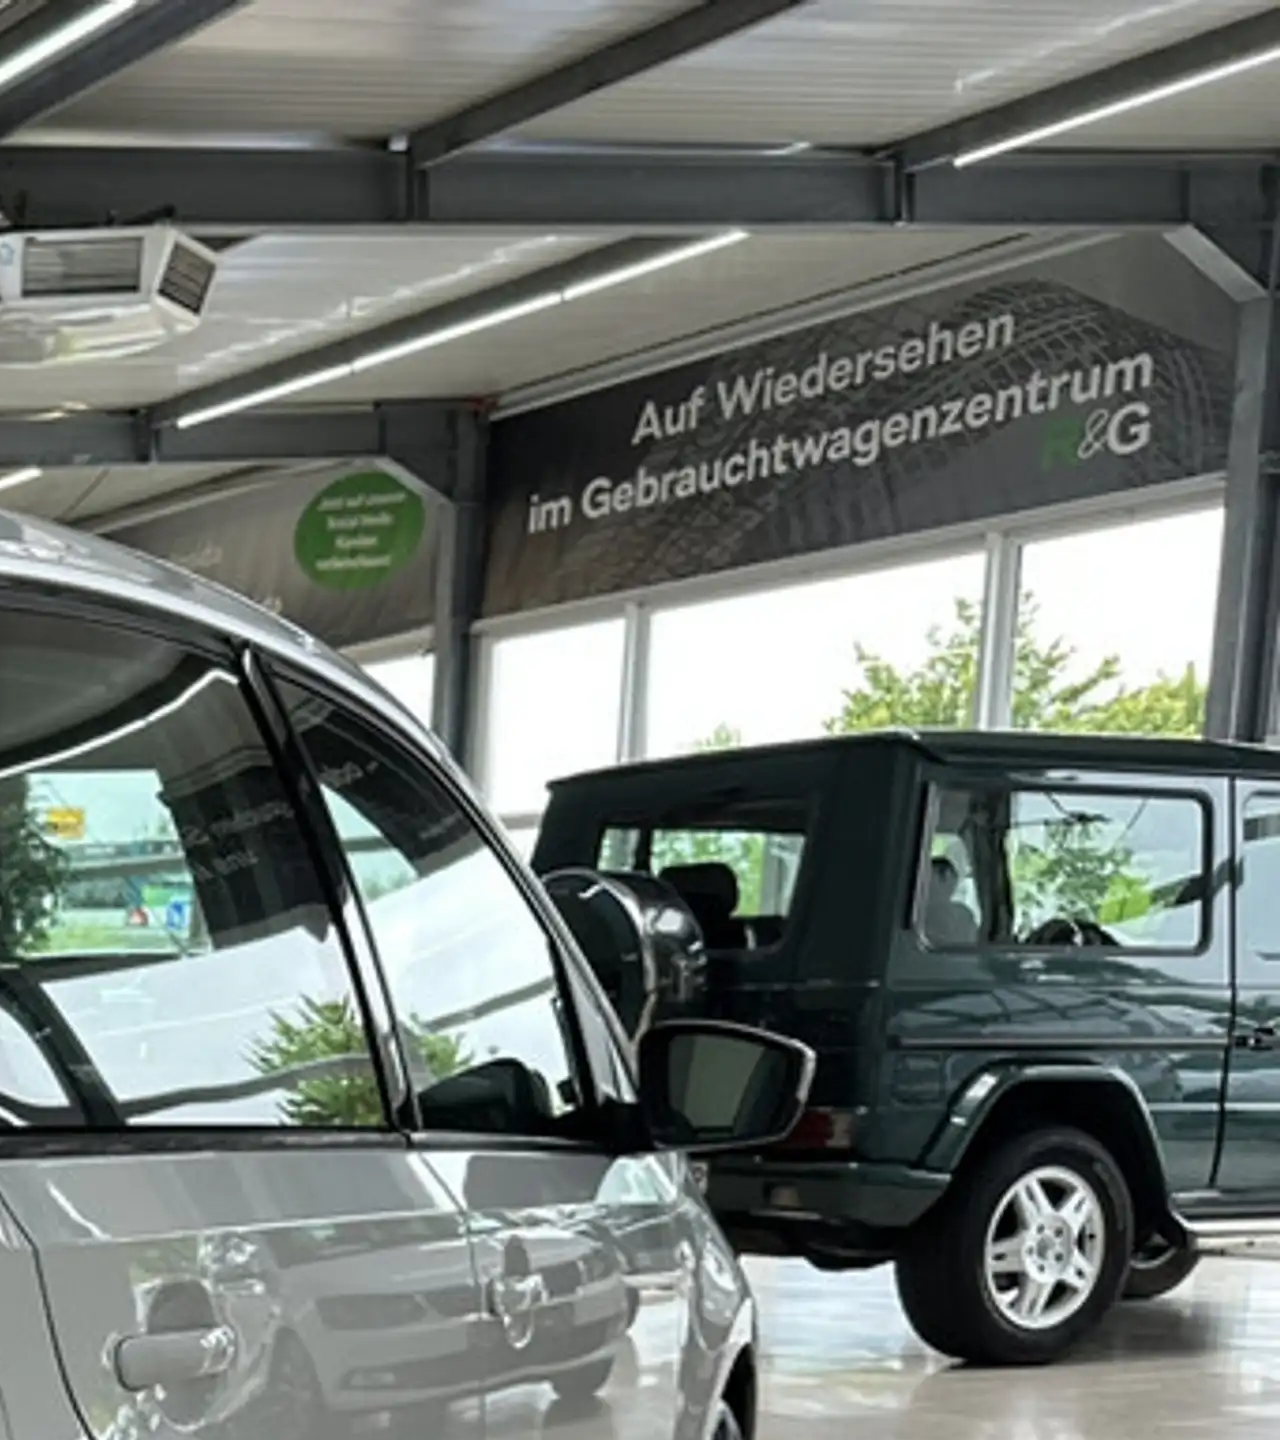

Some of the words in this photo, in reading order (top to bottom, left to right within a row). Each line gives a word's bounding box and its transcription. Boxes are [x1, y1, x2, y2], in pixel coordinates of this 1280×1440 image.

[528, 494, 573, 534] im
[581, 352, 1154, 520] Gebrauchtwagenzentrum
[631, 385, 707, 446] Auf
[717, 313, 1015, 421] Wiedersehen
